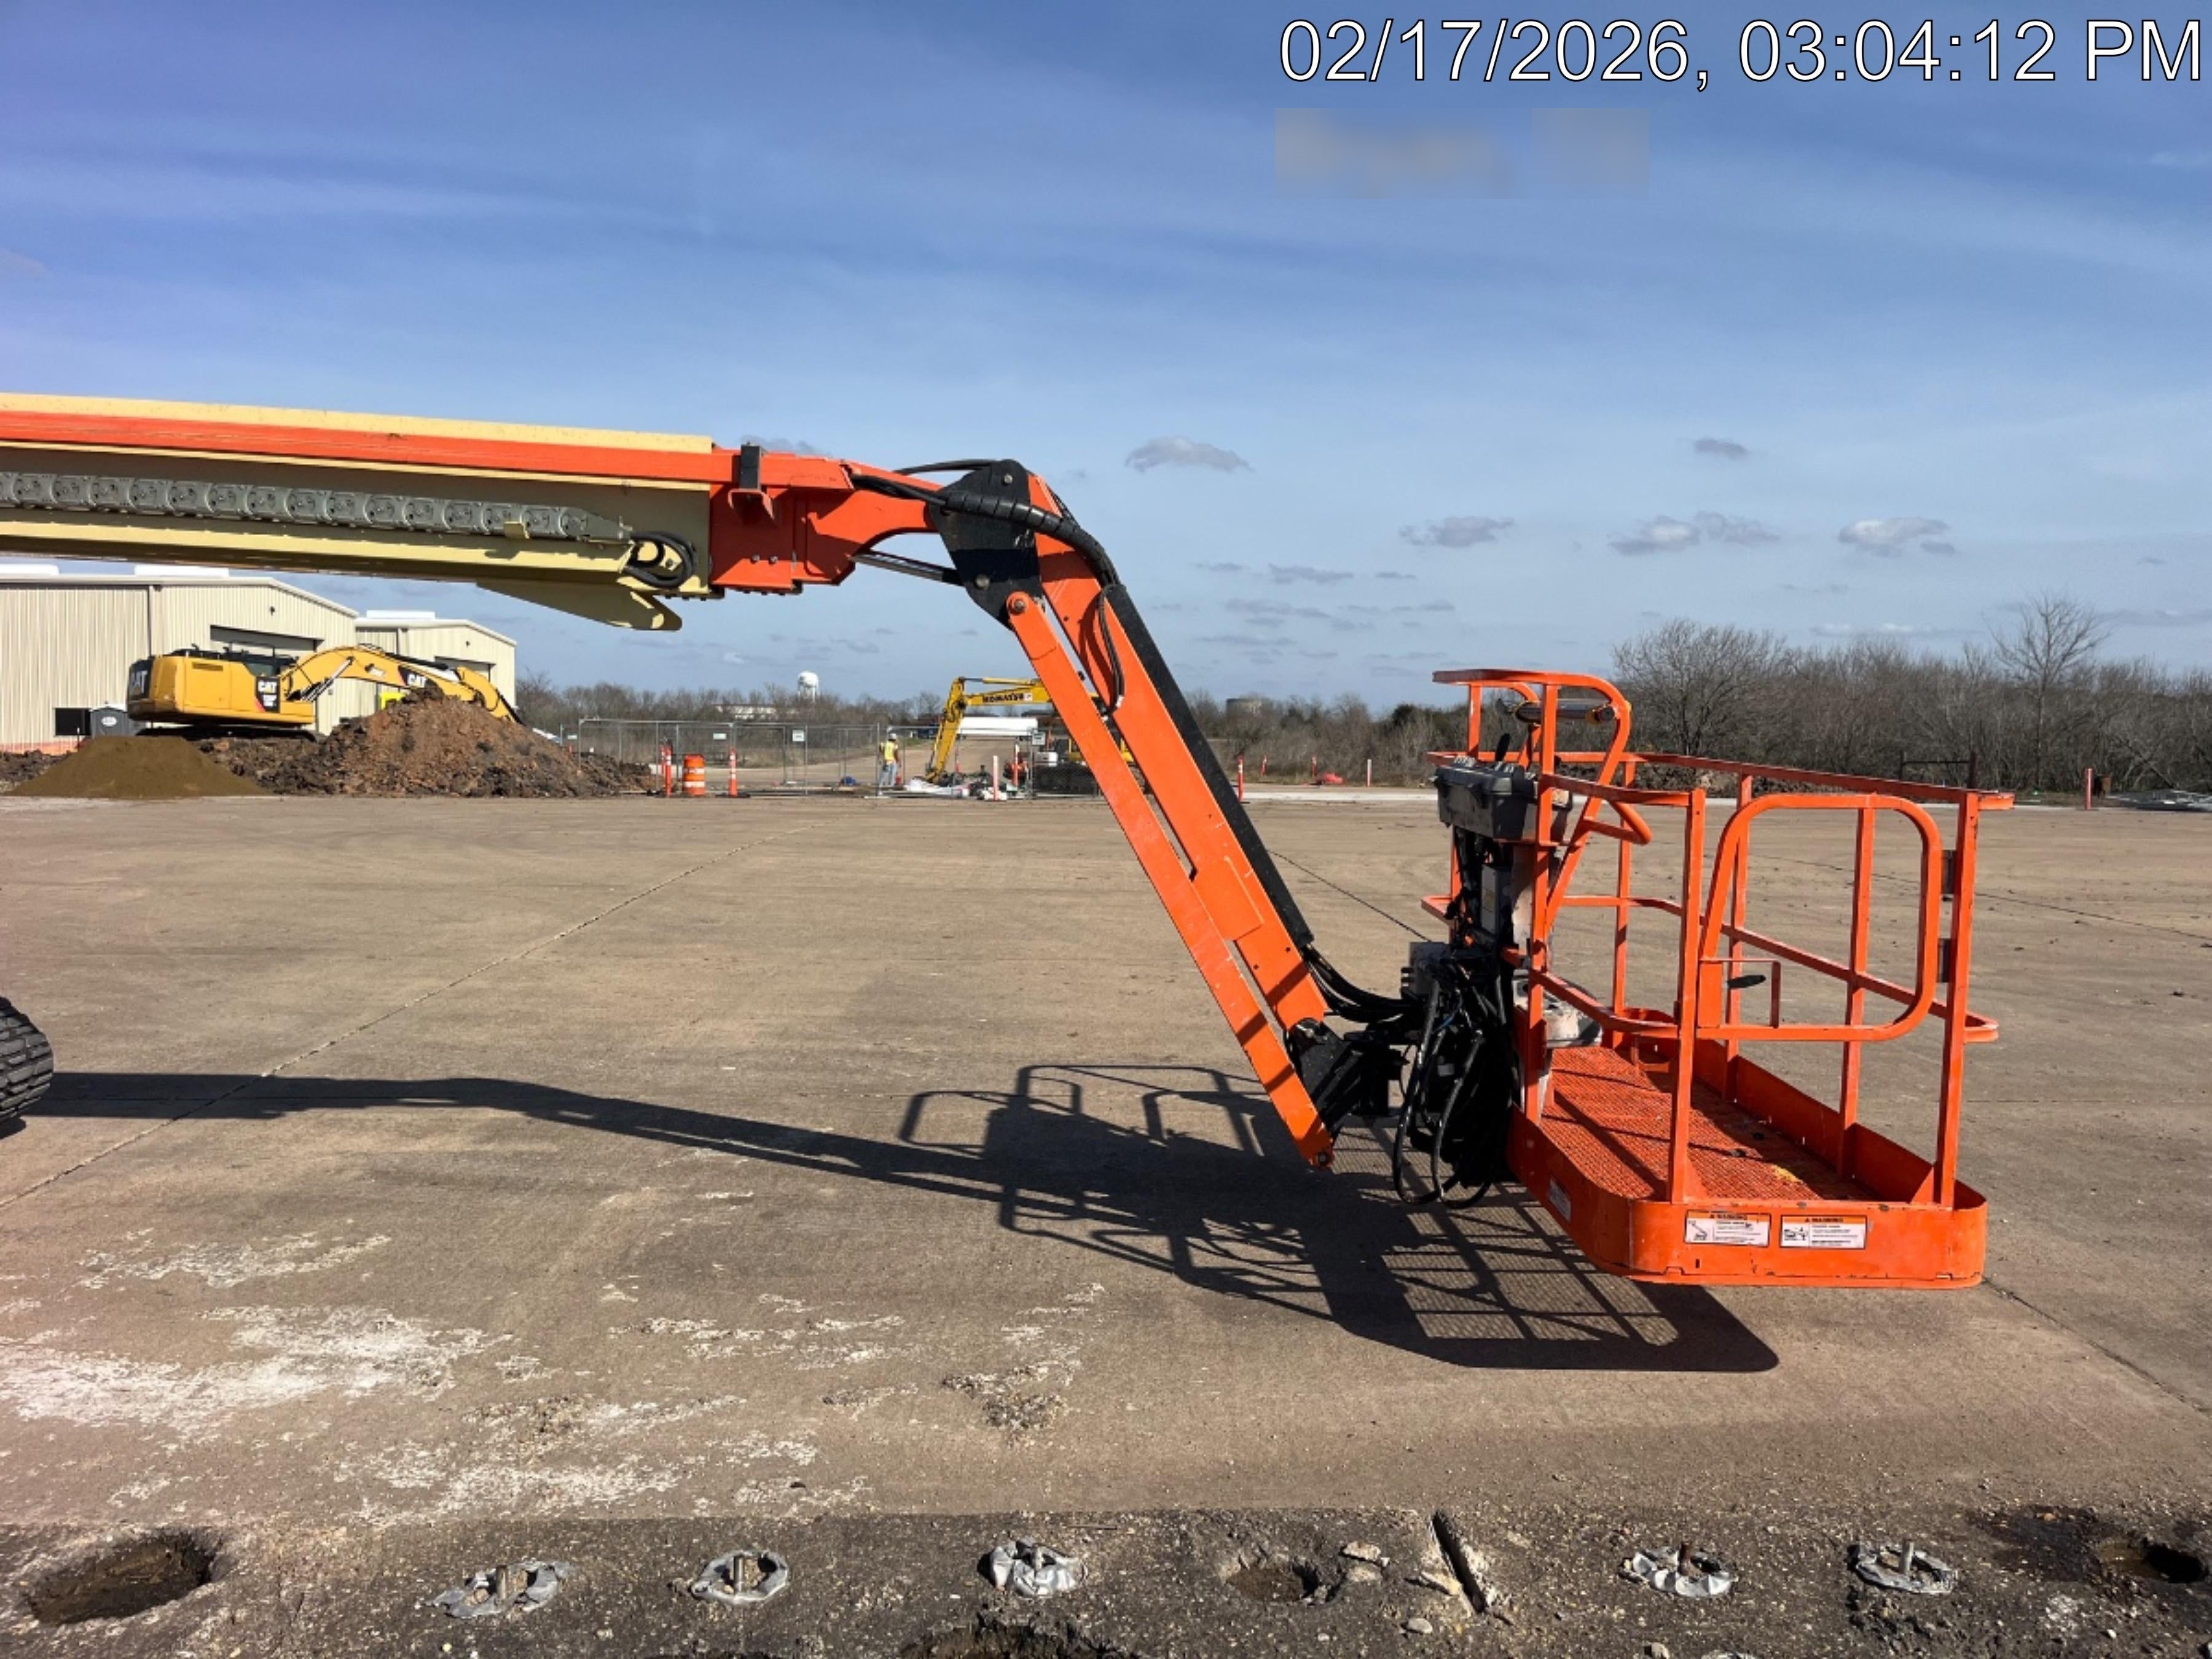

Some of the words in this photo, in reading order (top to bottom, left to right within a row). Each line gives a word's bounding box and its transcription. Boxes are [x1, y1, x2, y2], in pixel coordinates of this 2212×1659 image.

[258, 680, 277, 693] CAT
[407, 673, 426, 688] CAT
[983, 692, 1024, 703] KOMATSU
